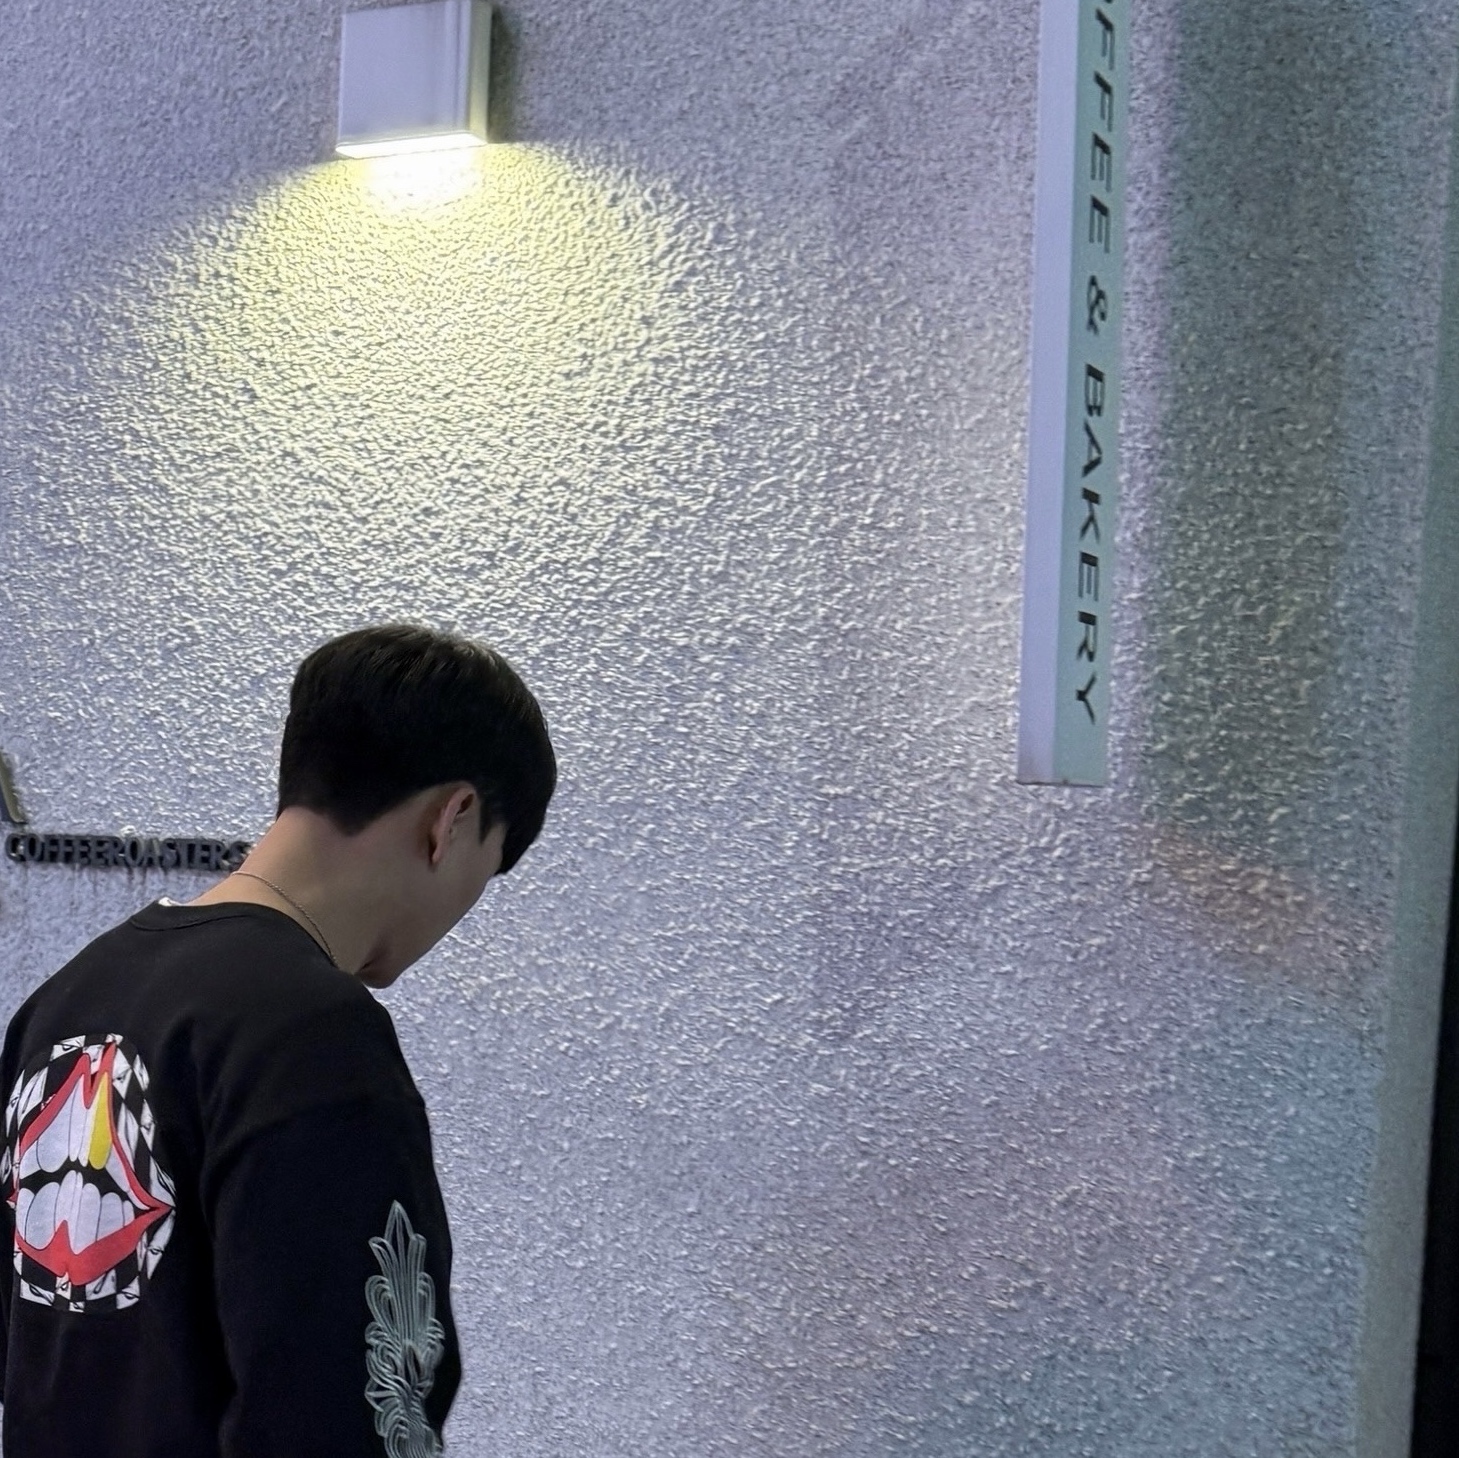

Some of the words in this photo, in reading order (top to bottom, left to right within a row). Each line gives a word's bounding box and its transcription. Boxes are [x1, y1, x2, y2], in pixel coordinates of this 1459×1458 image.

[1089, 0, 1115, 253] FFEE
[1086, 275, 1109, 335] &
[1075, 362, 1106, 725] BAKERY
